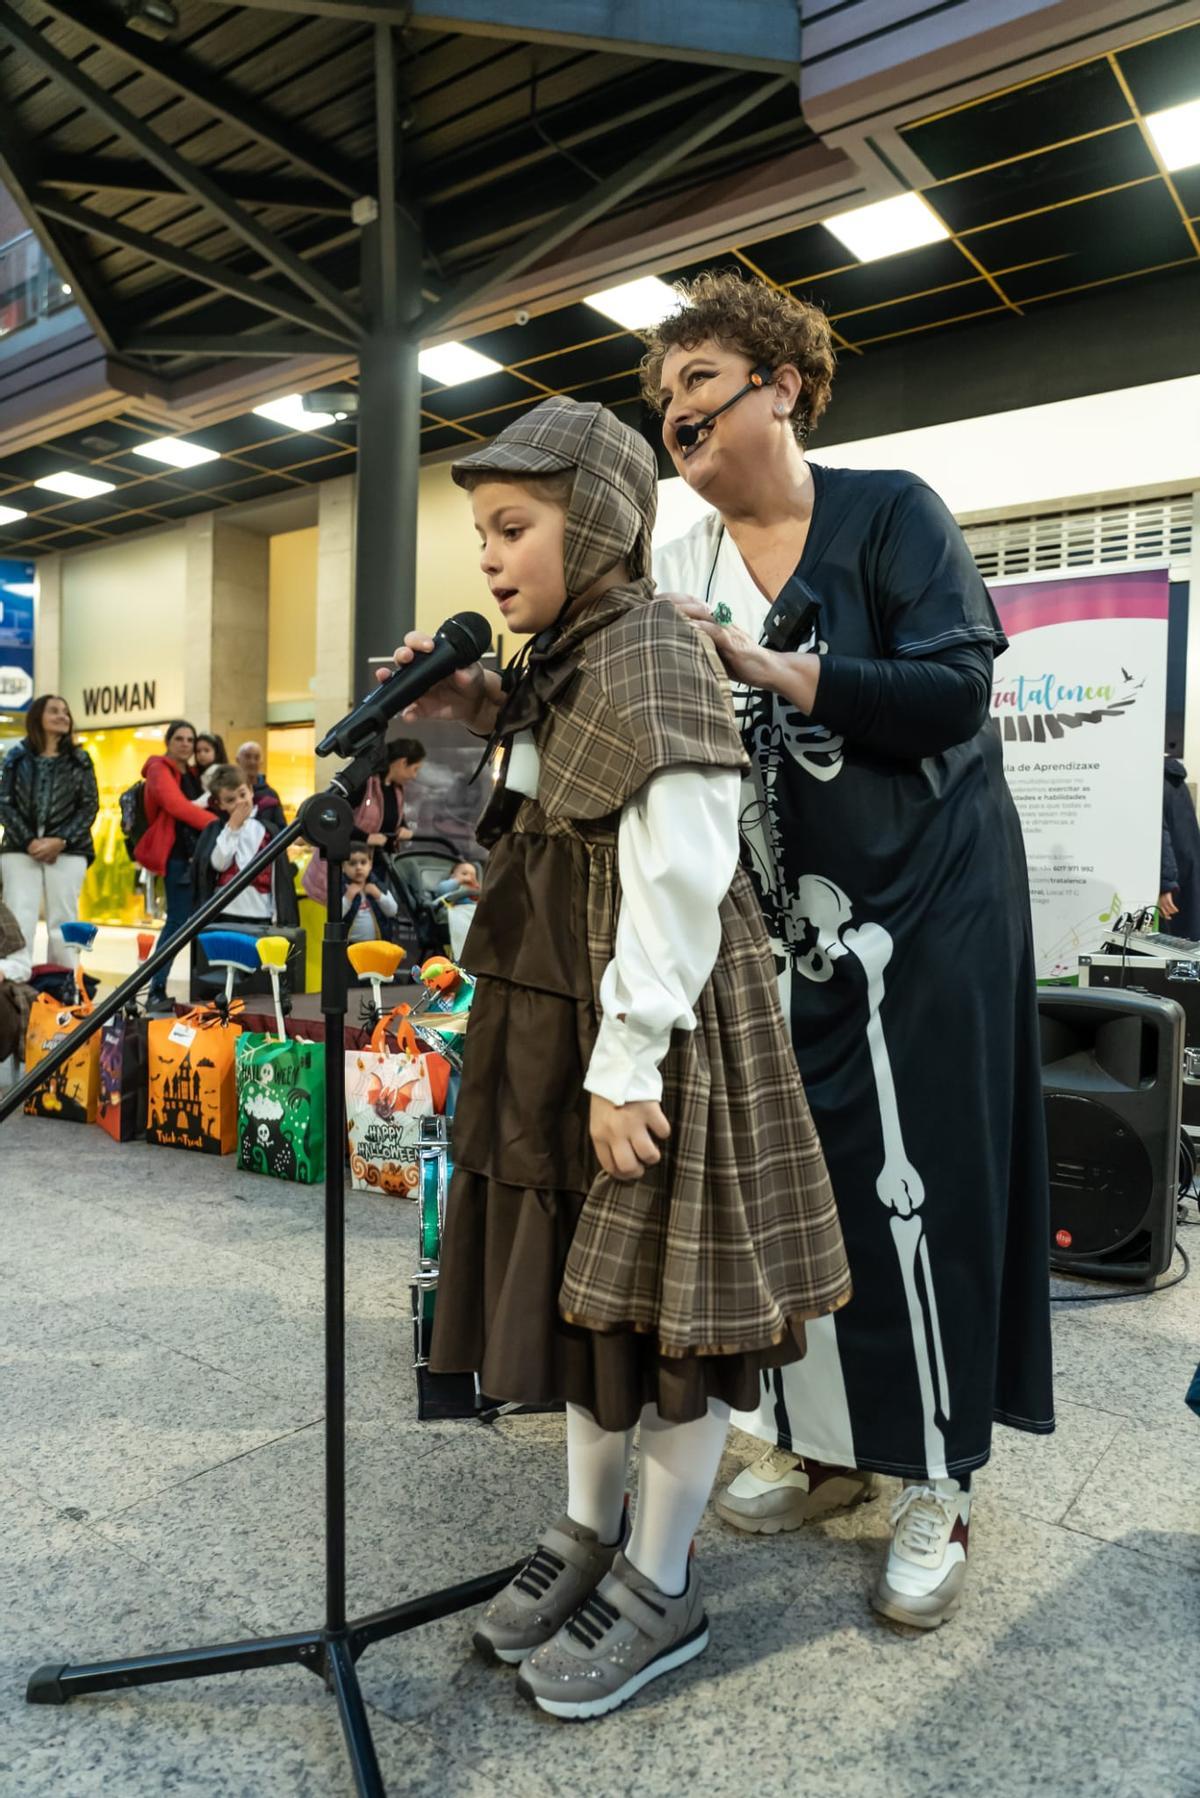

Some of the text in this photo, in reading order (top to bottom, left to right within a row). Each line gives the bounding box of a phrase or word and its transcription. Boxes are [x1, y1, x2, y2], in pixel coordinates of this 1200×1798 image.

[83, 680, 155, 716] WOMAN
[993, 674, 1112, 711] ratalenca
[1017, 763, 1030, 772] de
[1033, 762, 1100, 773] Aprendizaxe
[367, 1125, 403, 1145] HAPPY
